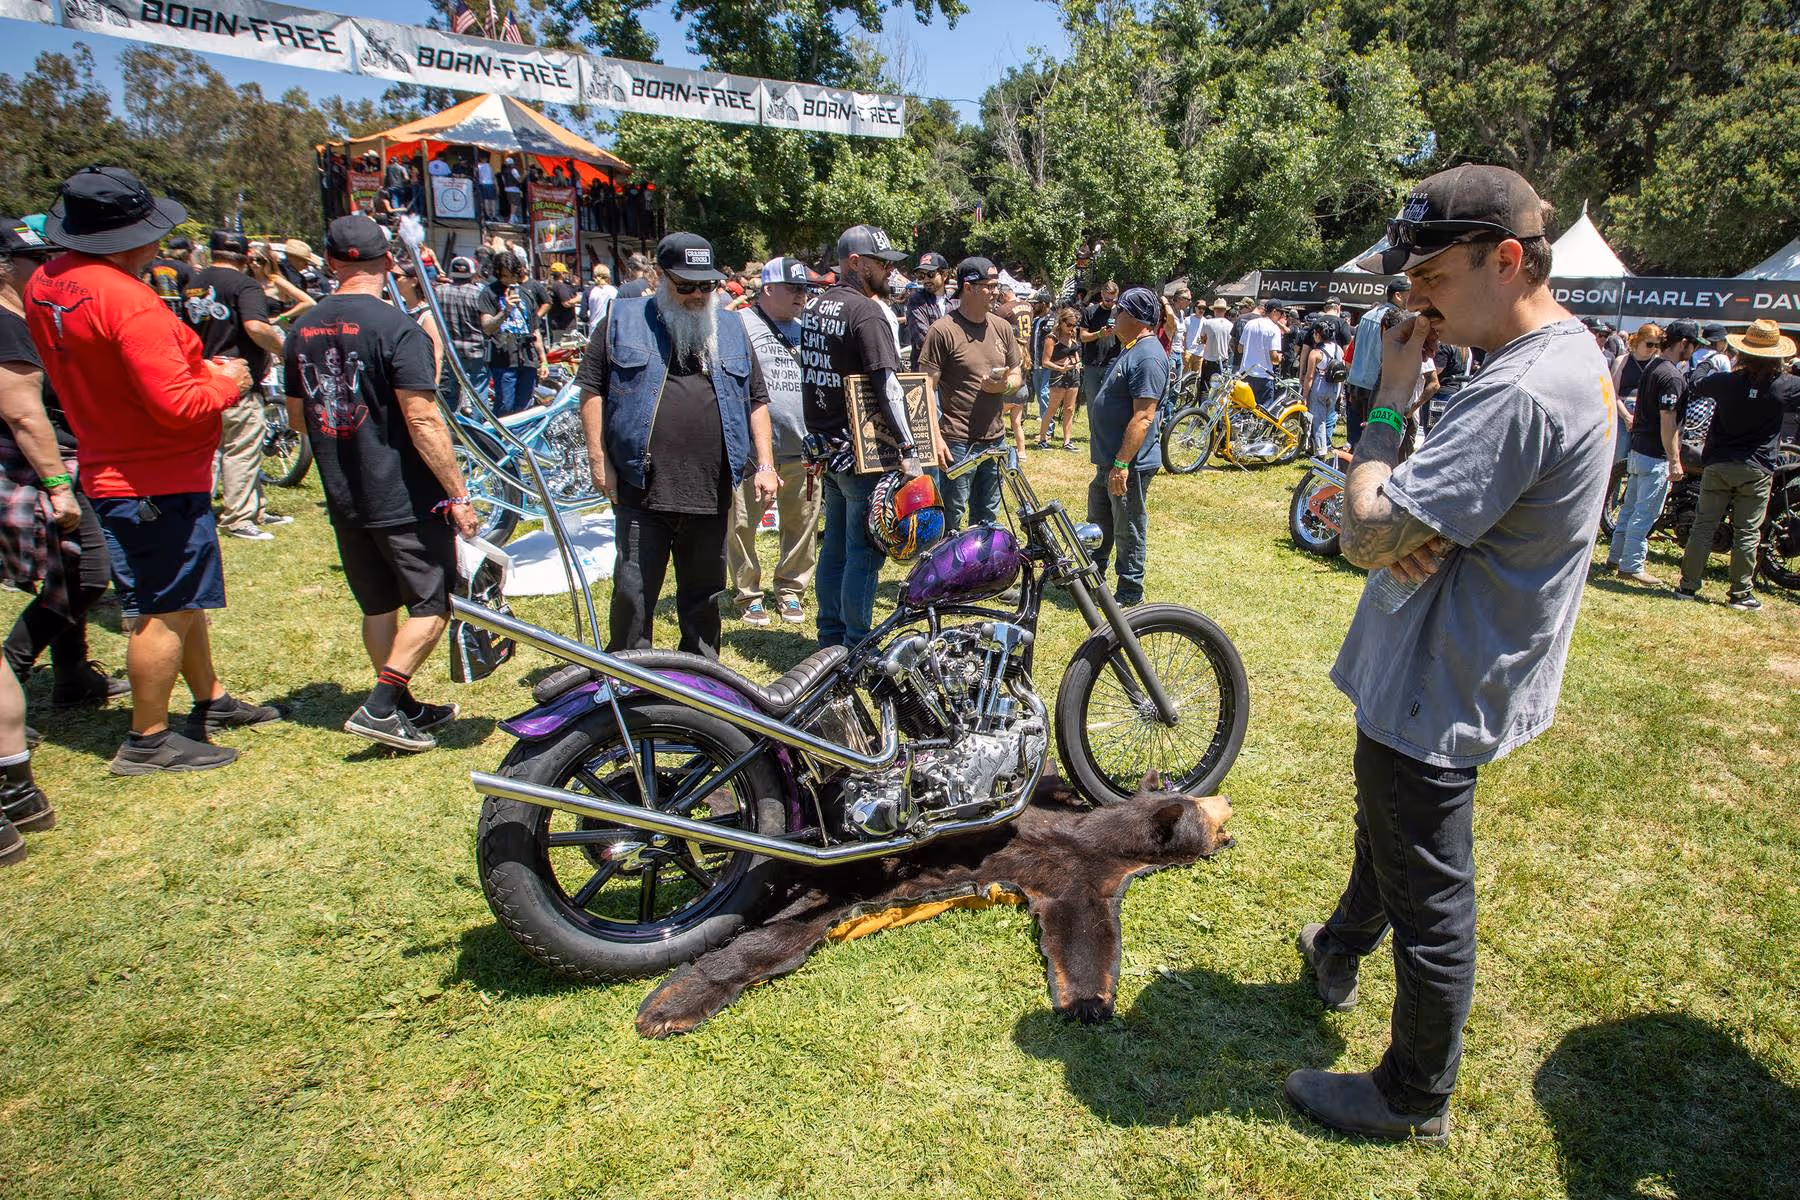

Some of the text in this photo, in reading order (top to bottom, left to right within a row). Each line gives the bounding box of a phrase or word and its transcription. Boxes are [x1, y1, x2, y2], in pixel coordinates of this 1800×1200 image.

[140, 0, 343, 54] BORN-FREE
[416, 45, 572, 88] BORN-FREE
[632, 77, 756, 110] BORN-FREE
[819, 300, 845, 317] ONE
[821, 317, 846, 337] YOU
[1017, 314, 1031, 337] 13
[760, 343, 789, 357] OWES
[771, 369, 801, 381] WORK
[767, 380, 803, 393] HARDE
